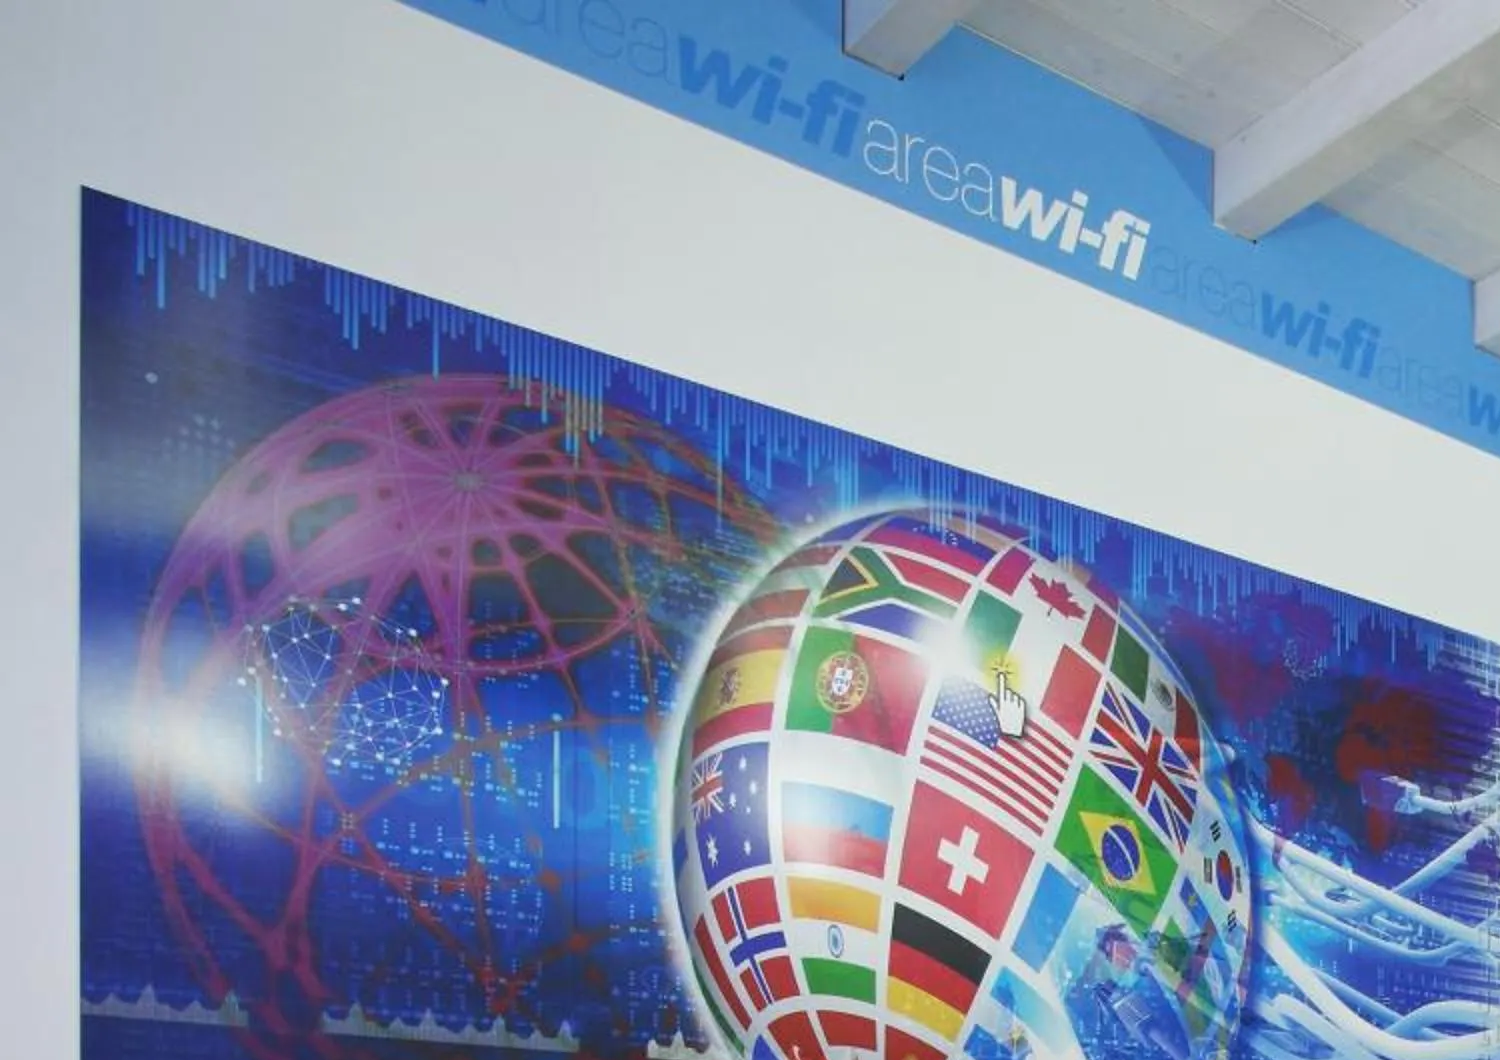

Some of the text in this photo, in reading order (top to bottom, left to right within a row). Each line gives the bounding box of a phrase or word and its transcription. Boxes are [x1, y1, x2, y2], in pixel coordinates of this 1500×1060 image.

[677, 31, 868, 160] wi-fi
[863, 119, 997, 222] area
[1001, 175, 1150, 281] wi-fi
[1260, 289, 1383, 380] wi-fi
